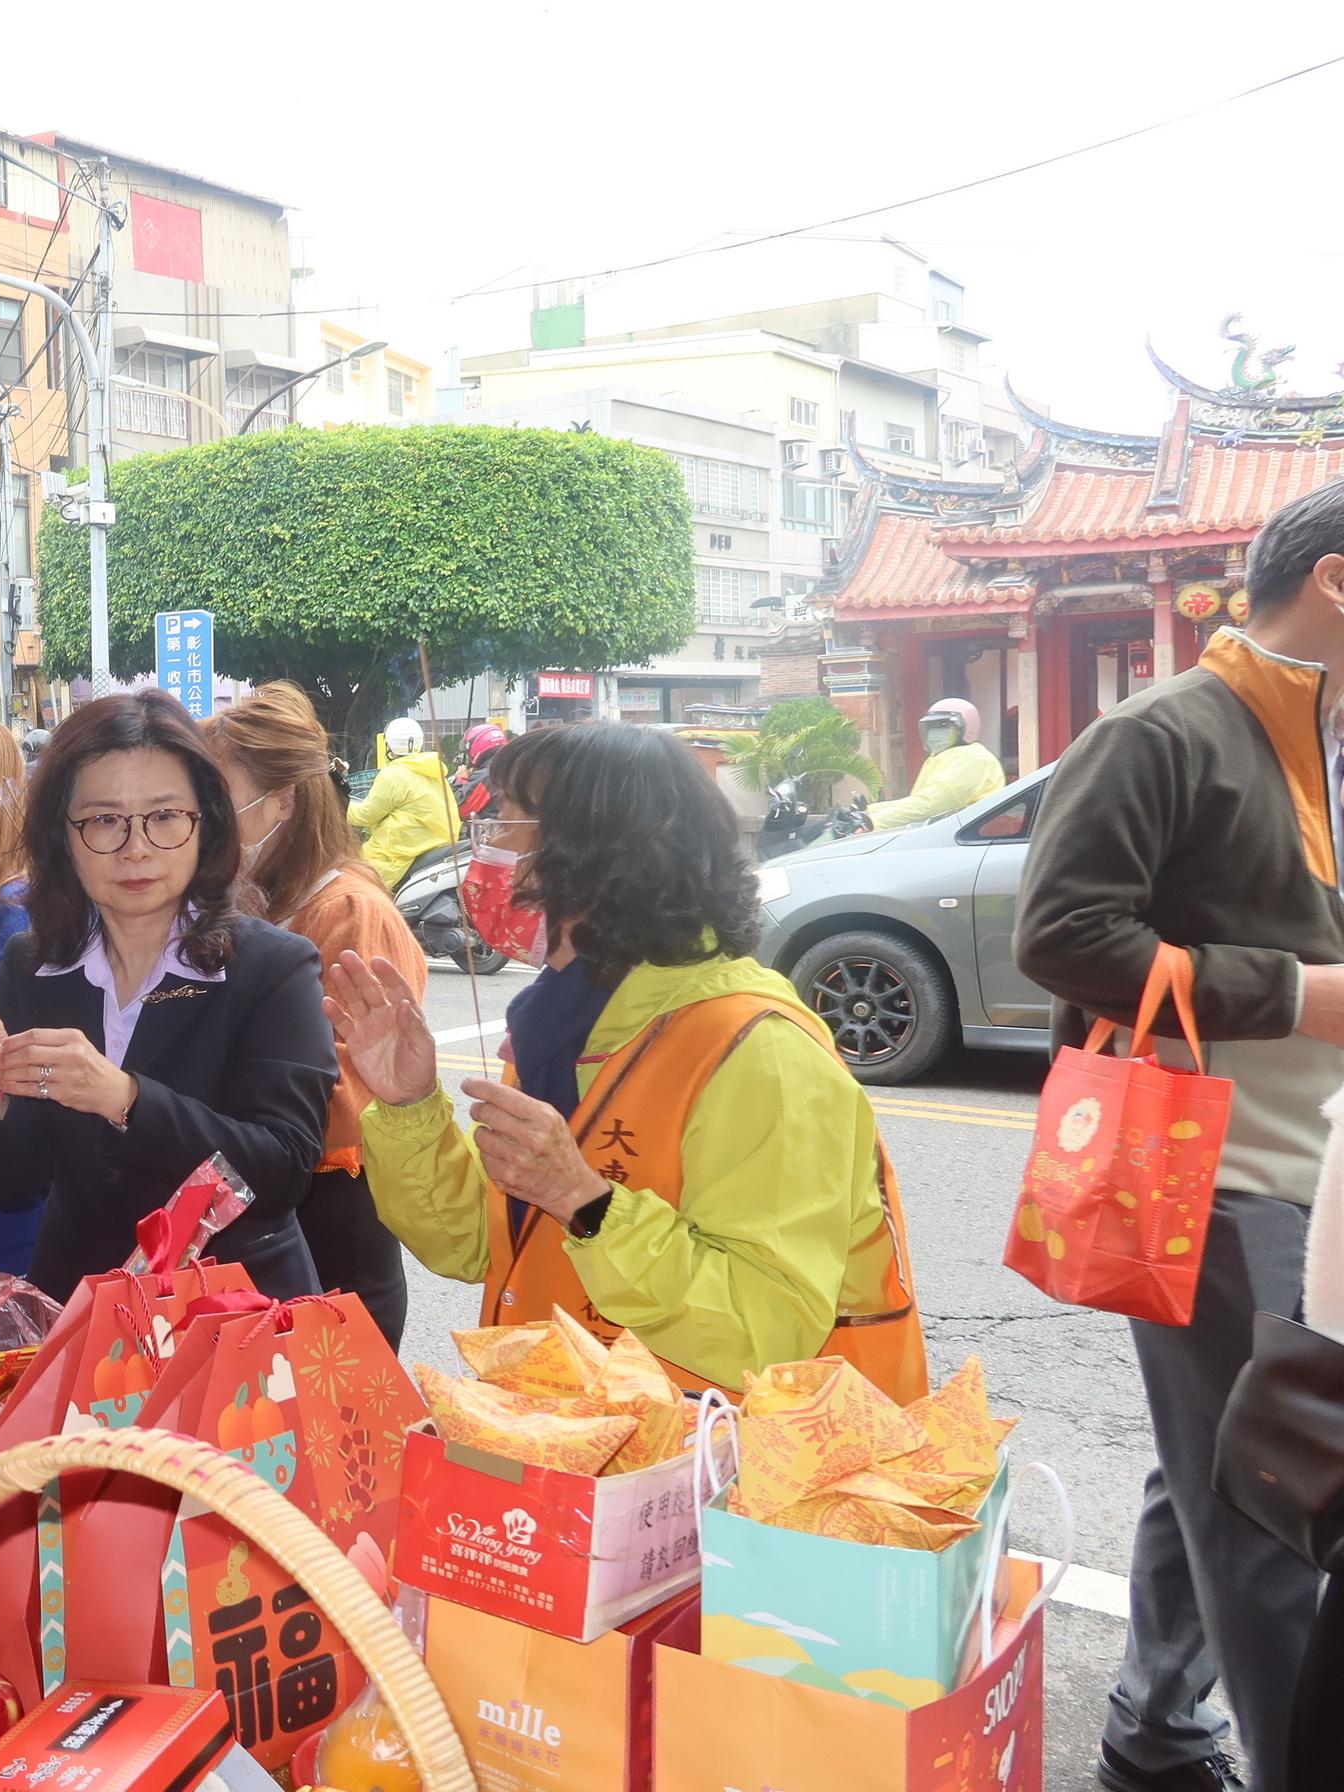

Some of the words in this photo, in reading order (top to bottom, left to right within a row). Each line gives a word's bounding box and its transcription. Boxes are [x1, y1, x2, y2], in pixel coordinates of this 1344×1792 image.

[1183, 592, 1216, 616] 帝
[208, 1582, 338, 1749] 福
[477, 1698, 562, 1747] mille
